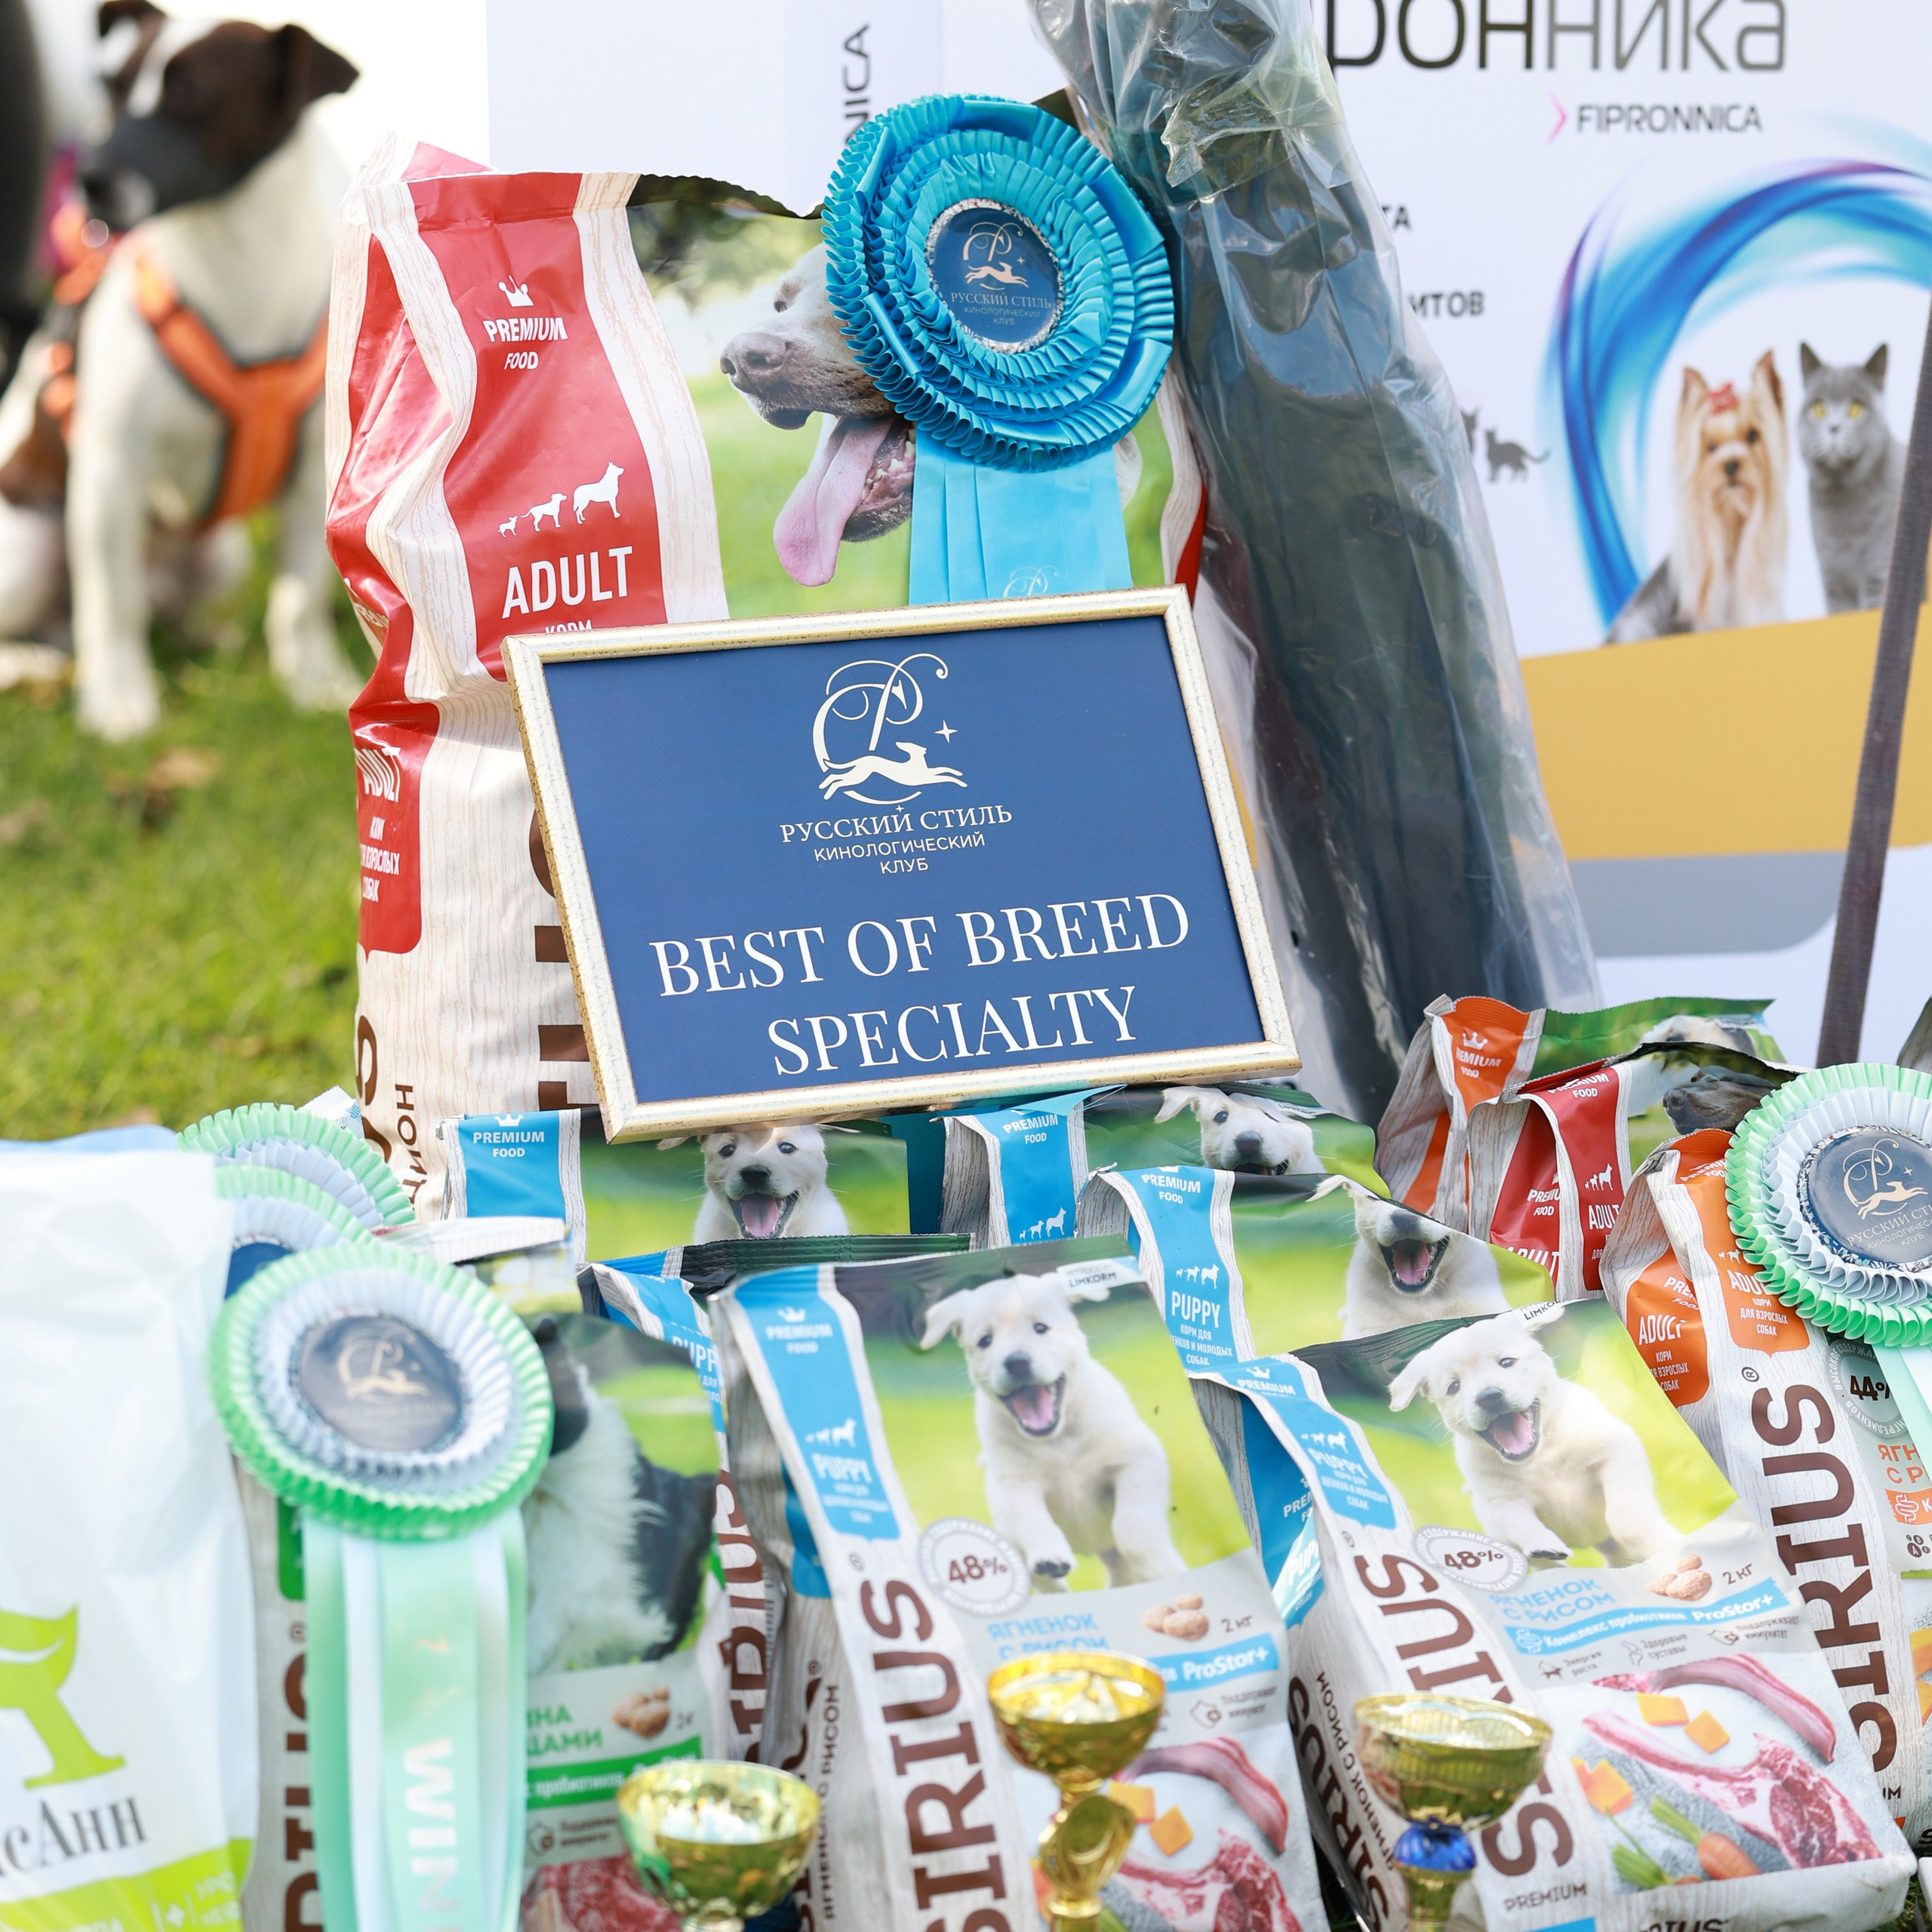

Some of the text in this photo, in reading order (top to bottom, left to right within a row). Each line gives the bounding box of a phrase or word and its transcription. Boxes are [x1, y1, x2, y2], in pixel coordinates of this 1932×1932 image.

[842, 23, 870, 145] NICA
[1577, 103, 1764, 134] FIPRONNICA
[951, 292, 1051, 309] РУССКИЙ СТИЛЬ
[1408, 291, 1484, 318] ИТОВ
[964, 306, 1041, 318] КИНОЛОГИЧЕСКИЙ
[993, 317, 1015, 325] КЛУБ
[482, 316, 568, 343] PREMIUM
[503, 351, 540, 371] FOOD
[501, 546, 634, 619] ADULT
[780, 804, 1014, 843] РУССКИЙ СТИЛЬ
[814, 830, 986, 862] КИНОЛОГИЧЕСКИЙ
[880, 857, 929, 875] КЛУБ
[649, 893, 1189, 998] BEST OF BREED
[768, 985, 1137, 1076] SPECIALTY
[1572, 1088, 1598, 1099] FOOD
[1002, 1114, 1059, 1134] PREMIUM
[473, 1131, 545, 1145] PREMIUM
[1024, 1132, 1048, 1145] FOOD
[493, 1148, 526, 1158] FOOD
[1141, 1174, 1201, 1193] PREMIUM
[1703, 1169, 1727, 1178] FOO
[1159, 1191, 1183, 1204] FOOD
[1527, 1188, 1561, 1203] PREMIU
[1533, 1205, 1555, 1217] FOOD
[1588, 1204, 1620, 1230] ADULT
[1847, 1211, 1910, 1247] РУССКИЙ
[1900, 1232, 1924, 1247] КЛУБ
[1068, 1271, 1118, 1288] LIMKORM
[1171, 1291, 1221, 1329] PUPPY
[1524, 1300, 1565, 1321] LIMKO
[1752, 1297, 1772, 1309] КОРМ
[1740, 1307, 1789, 1325] ДЛЯ ВЗРОСЛЫХ
[765, 1322, 833, 1341] PREMIUM
[1180, 1323, 1212, 1341] КОРМ ДЛЯ
[1638, 1313, 1687, 1346] ADULT
[1756, 1324, 1777, 1337] СОБАК
[1171, 1334, 1233, 1358] ЕНКОВ И МОЛОДЫХ
[1655, 1349, 1672, 1363] КОРМ
[1186, 1354, 1211, 1366] СОБАК
[1657, 1362, 1689, 1378] ВЗРОСЛЫХ
[1829, 1348, 1843, 1390] ВЫСОКОЕ
[1236, 1378, 1297, 1395] PREMIUM
[1660, 1378, 1680, 1392] СОБАК
[1845, 1400, 1907, 1435] НГРЕДИЕНТОВ
[811, 1452, 873, 1484] PUPPY
[1307, 1447, 1368, 1479] PUPPY
[1346, 1495, 1370, 1510] СОБАК
[949, 1555, 1008, 1583] 48%
[1444, 1549, 1504, 1571] 48%
[1722, 1564, 1754, 1585] 2 кг
[1488, 1578, 1603, 1606] ЯГНЕНОК
[986, 1612, 1099, 1641] ЯГНЕНОК
[1221, 1619, 1234, 1633] 2
[1541, 1622, 1608, 1650] Комплекс
[1690, 1593, 1774, 1622] ProStor+
[1183, 1645, 1269, 1681] ProStor+
[1316, 1671, 1348, 1752] РИСОМ
[1504, 1882, 1588, 1912] PREMIUM
